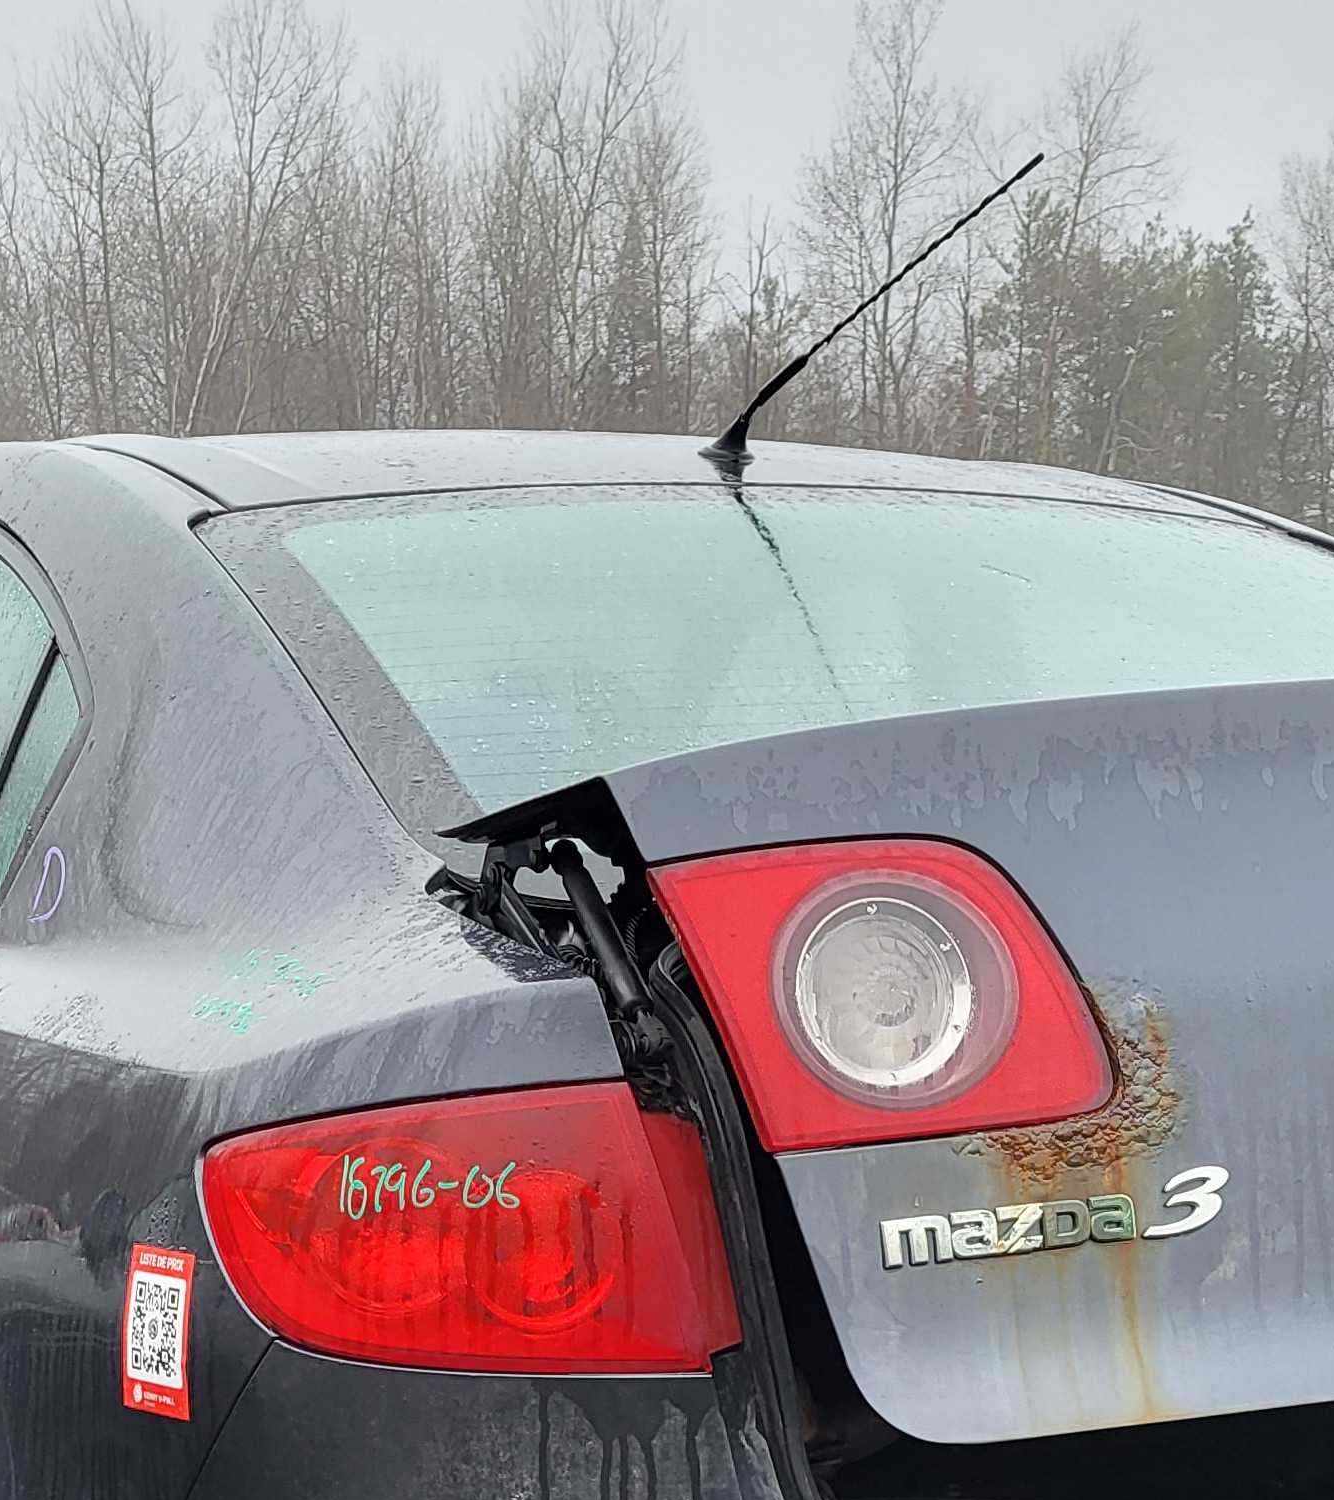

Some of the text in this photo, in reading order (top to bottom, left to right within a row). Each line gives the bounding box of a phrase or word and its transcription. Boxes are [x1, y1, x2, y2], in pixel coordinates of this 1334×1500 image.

[1142, 1165, 1230, 1240] 3
[139, 1251, 158, 1268] LISTE
[157, 1255, 168, 1270] DE
